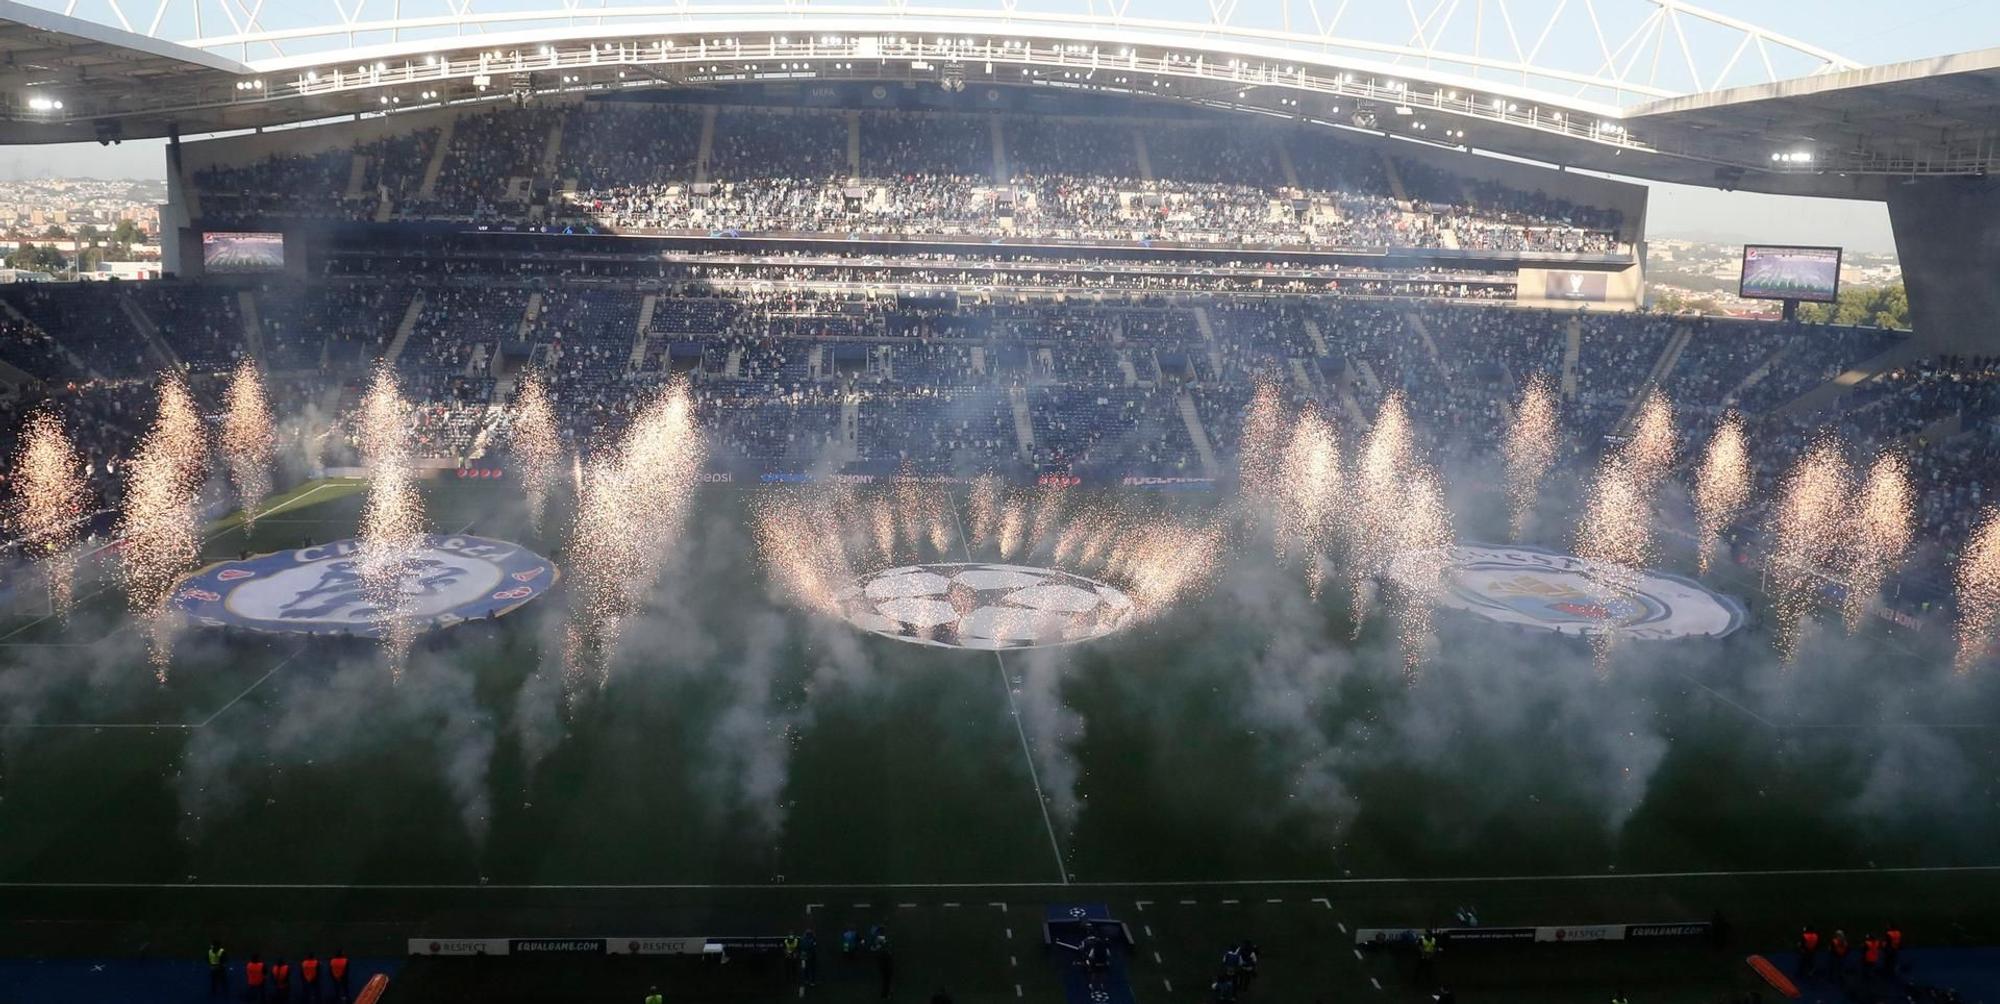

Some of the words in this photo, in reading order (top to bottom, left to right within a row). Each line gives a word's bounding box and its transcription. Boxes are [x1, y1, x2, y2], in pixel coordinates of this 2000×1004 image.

[1568, 929, 1606, 939] RESPECT
[443, 942, 487, 951] RESPECT
[517, 942, 598, 951] EQUALGAME.COM
[642, 941, 686, 951] RESPECT
